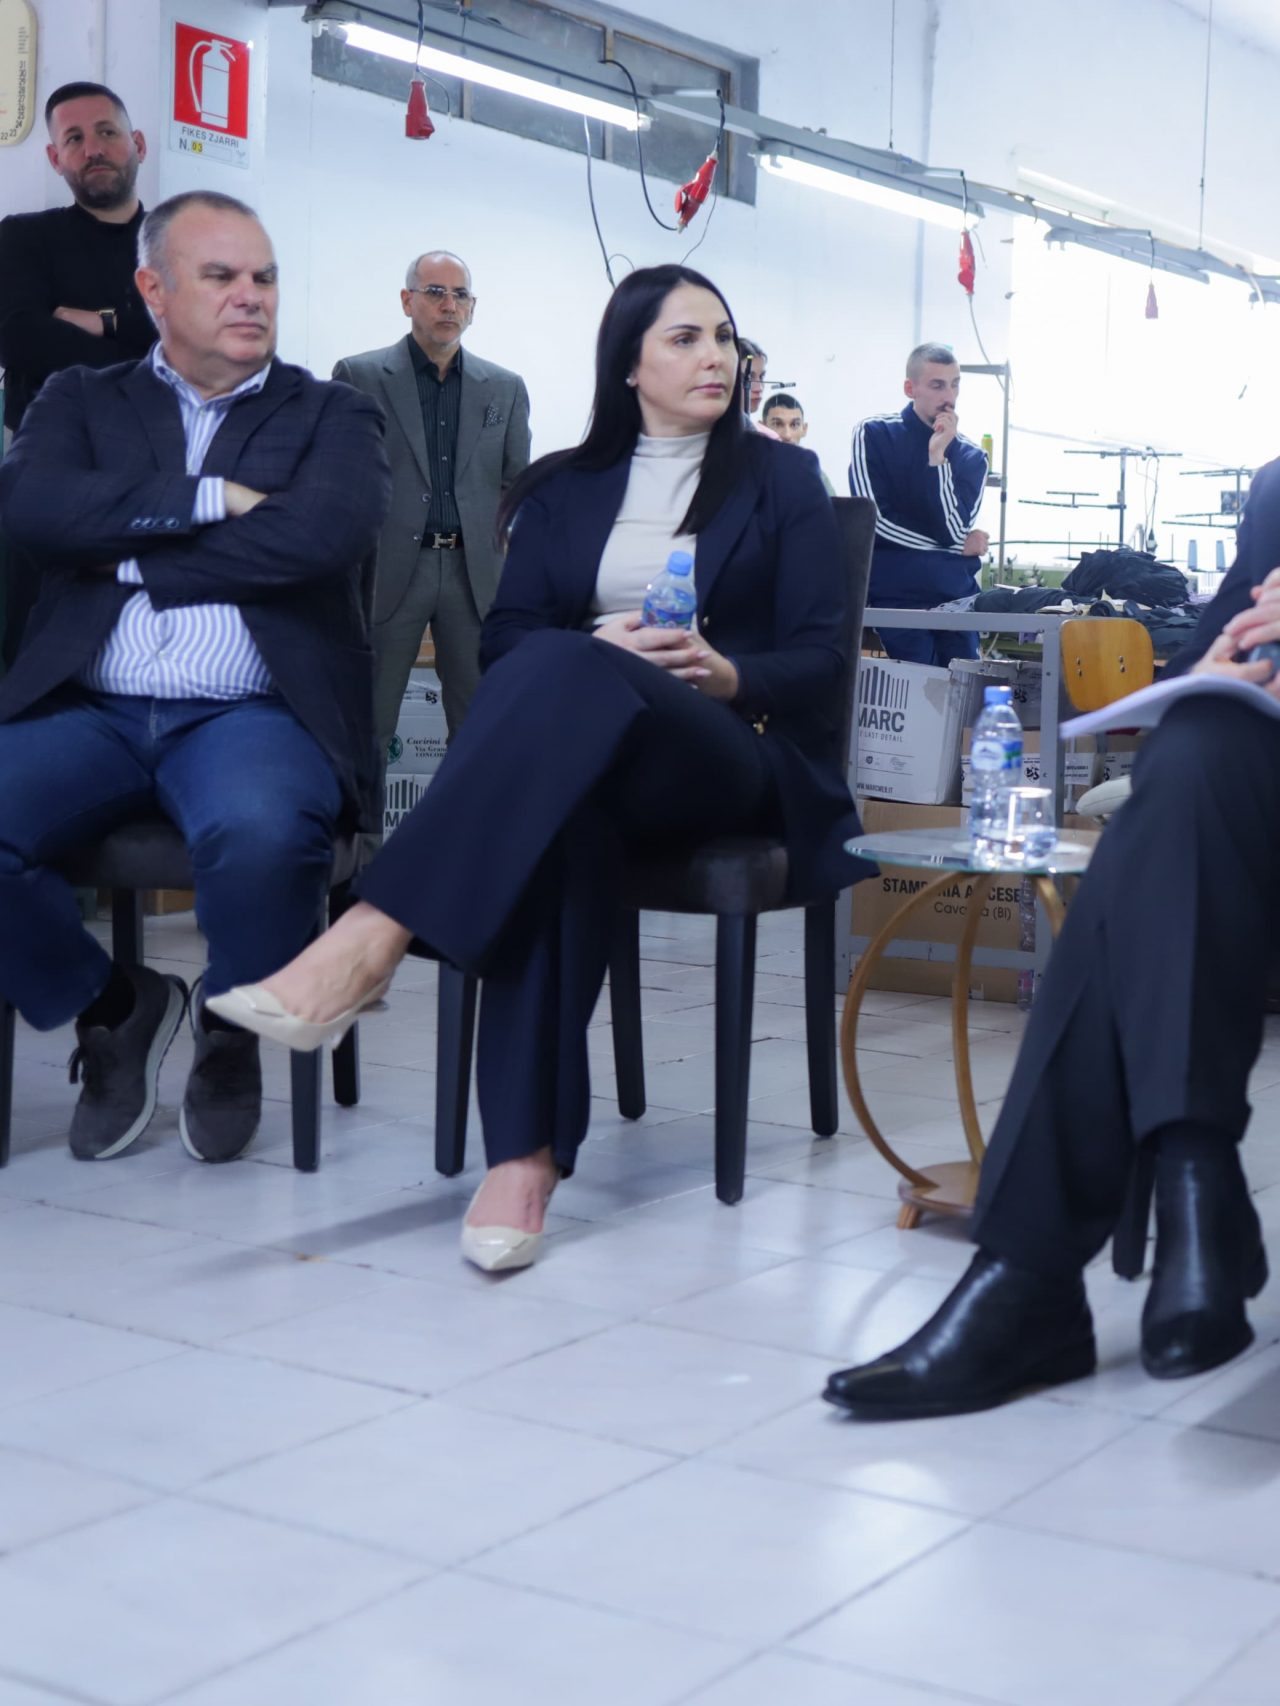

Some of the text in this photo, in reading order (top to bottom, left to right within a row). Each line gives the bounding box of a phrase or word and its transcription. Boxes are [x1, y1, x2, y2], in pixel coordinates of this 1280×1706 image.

[181, 126, 239, 149] FIKES ZJARRI
[858, 707, 905, 733] MARC
[880, 733, 903, 743] DETAIL
